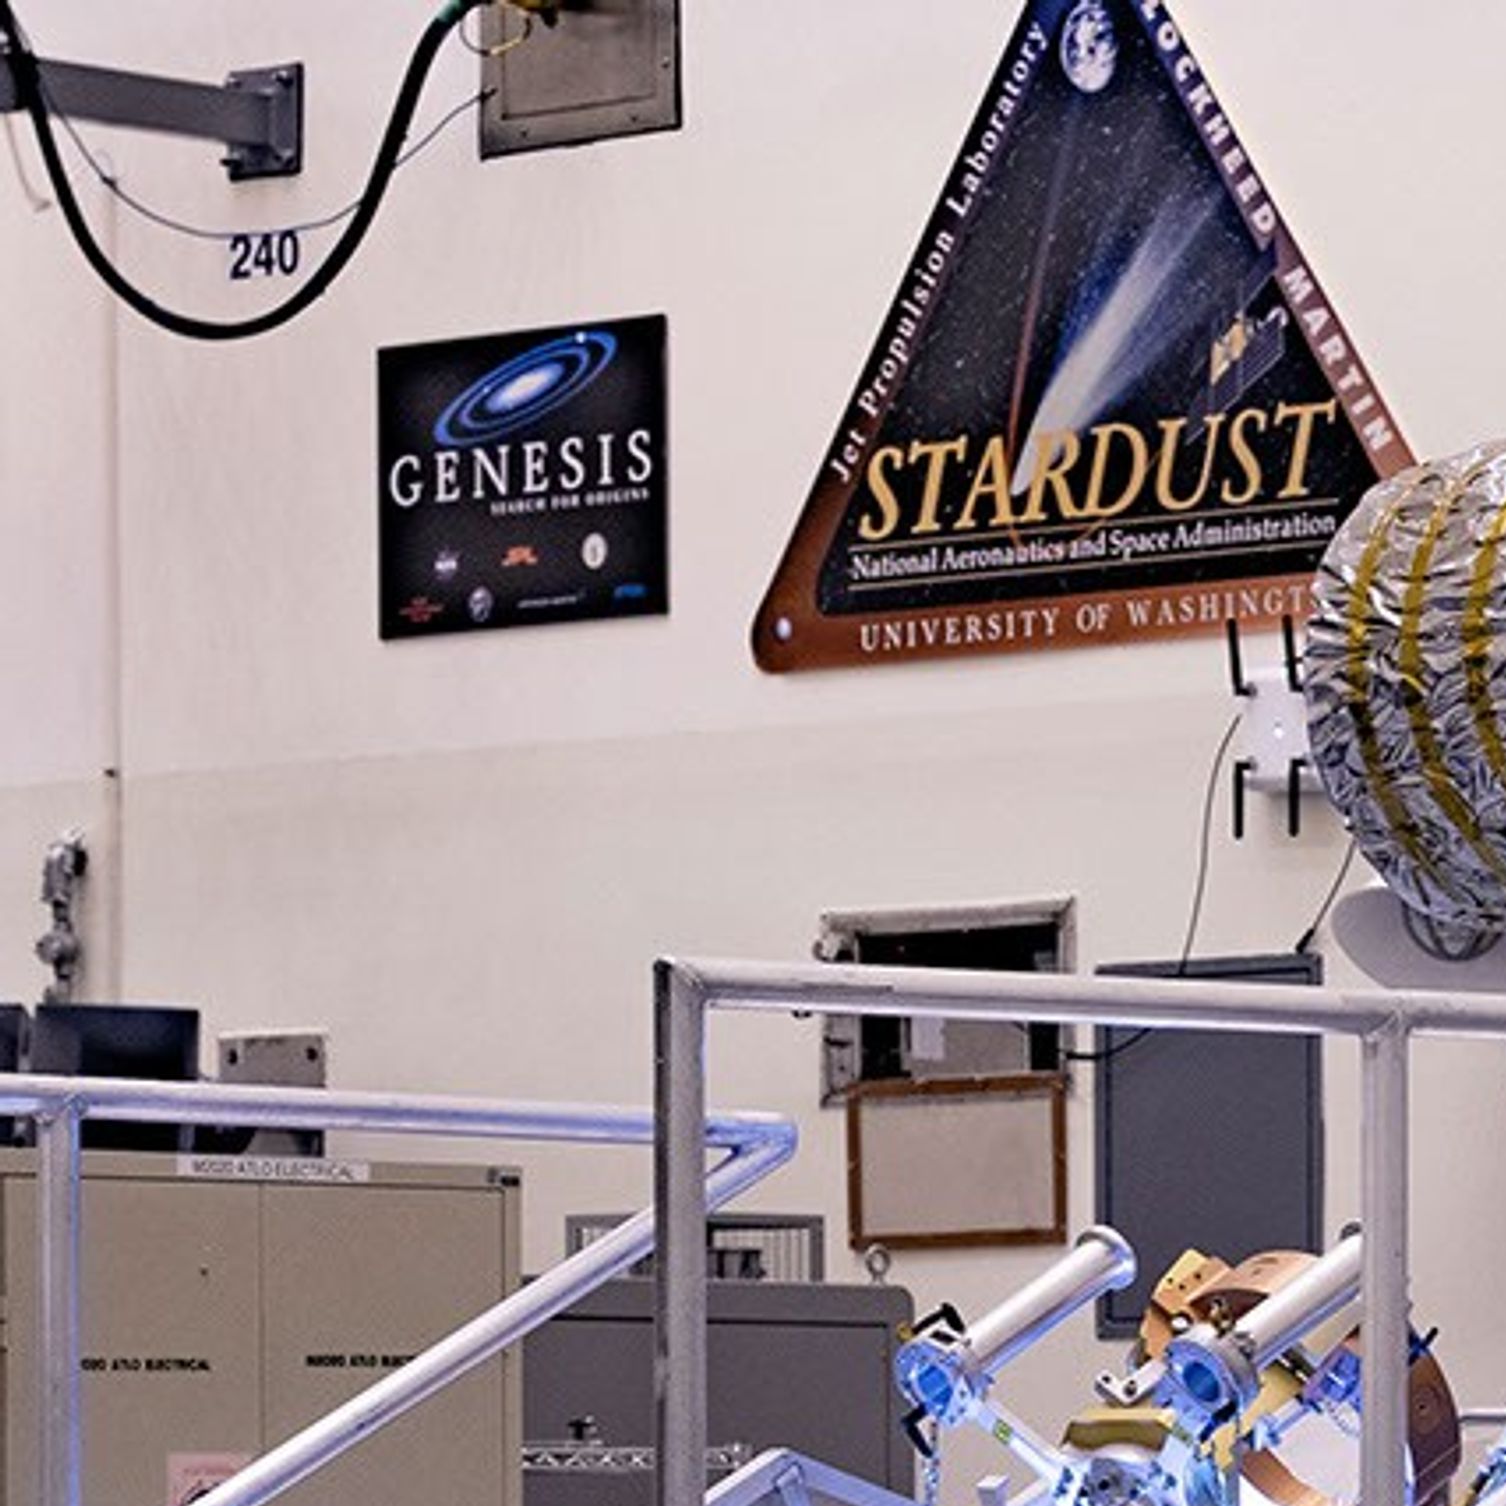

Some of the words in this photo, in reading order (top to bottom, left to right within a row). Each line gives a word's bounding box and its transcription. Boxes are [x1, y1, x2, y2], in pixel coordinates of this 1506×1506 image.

[230, 230, 298, 279] 240
[830, 429, 867, 482] Jet
[858, 230, 955, 418] Propulsion
[946, 21, 1048, 218] Laboratory
[1283, 264, 1393, 450] MARTIN
[390, 429, 652, 507] GENESIS
[858, 400, 1337, 541] STARDUST
[852, 546, 938, 580] National
[942, 536, 1064, 571] Aeronautics
[1070, 529, 1106, 560] and
[1108, 529, 1170, 562] Space
[1173, 511, 1336, 548] Administration
[859, 606, 1060, 652] UNIVERSITY
[1076, 602, 1111, 632] OF
